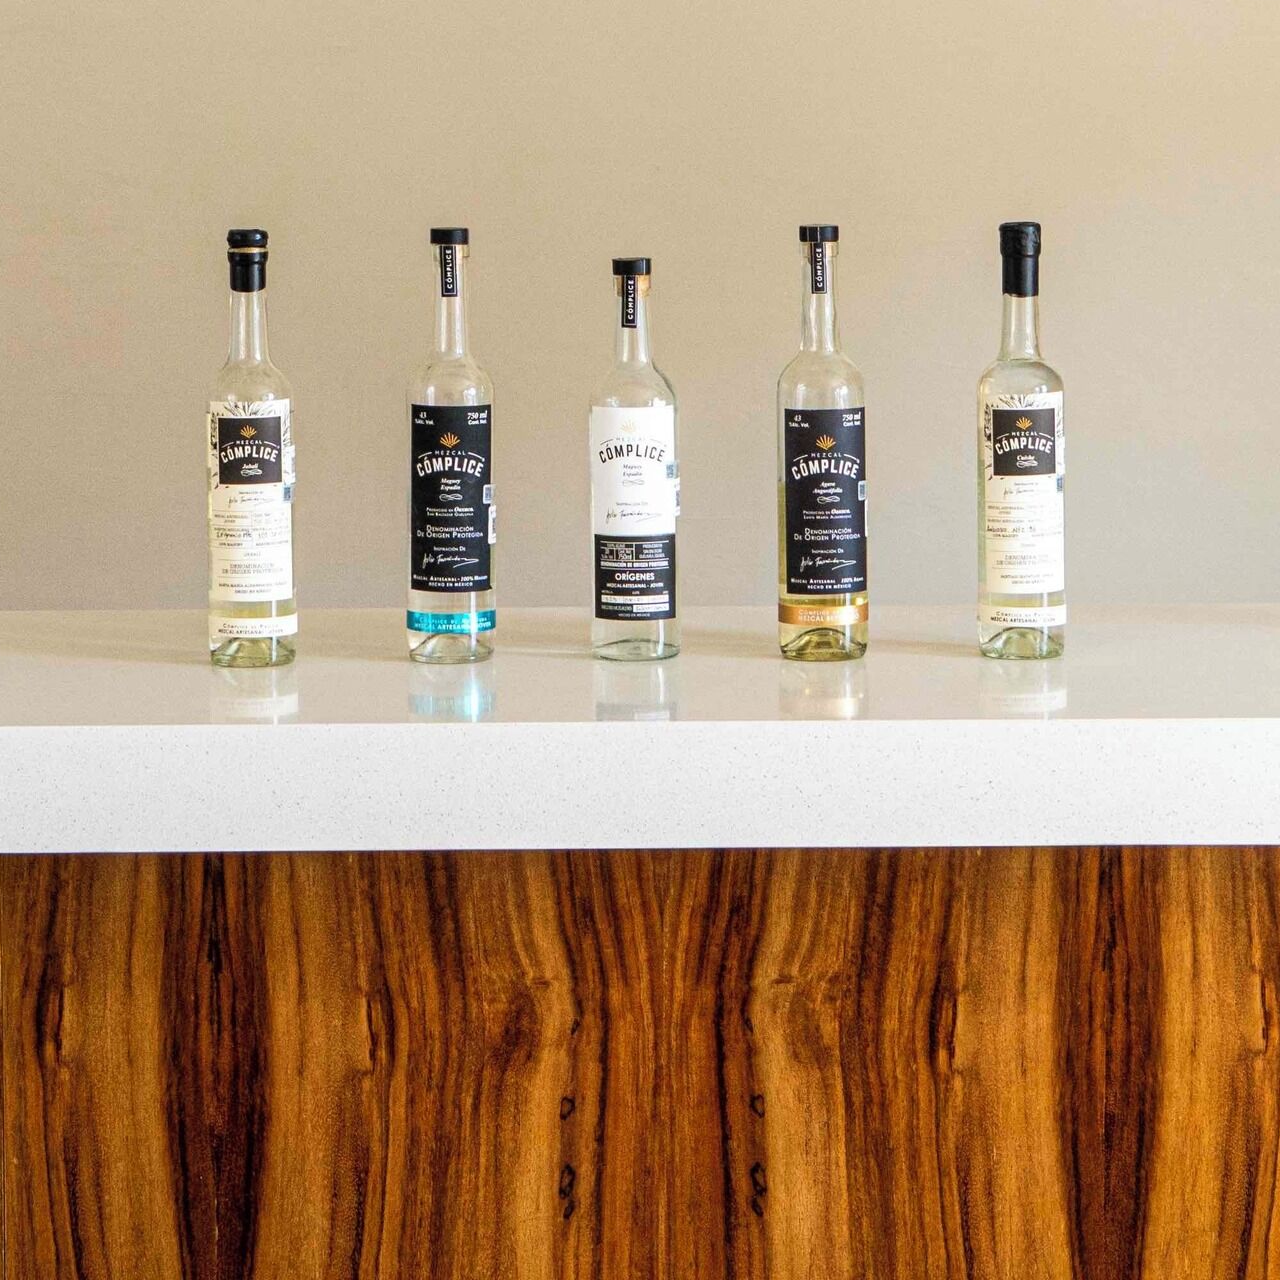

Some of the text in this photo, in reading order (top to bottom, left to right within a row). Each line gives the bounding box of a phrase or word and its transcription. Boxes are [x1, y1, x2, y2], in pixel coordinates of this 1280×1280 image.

[445, 249, 453, 289] CÓMPLICE
[815, 248, 823, 288] CÓMPLICE
[625, 280, 634, 320] CÓMPLICE
[220, 446, 279, 463] CÓMPLICE
[598, 444, 665, 464] CÓMPLICE
[995, 437, 1053, 454] CÓMPLICE
[416, 456, 484, 478] CÓMPLICE
[792, 459, 860, 480] CÓMPLICE
[615, 571, 655, 580] ORÍGENES
